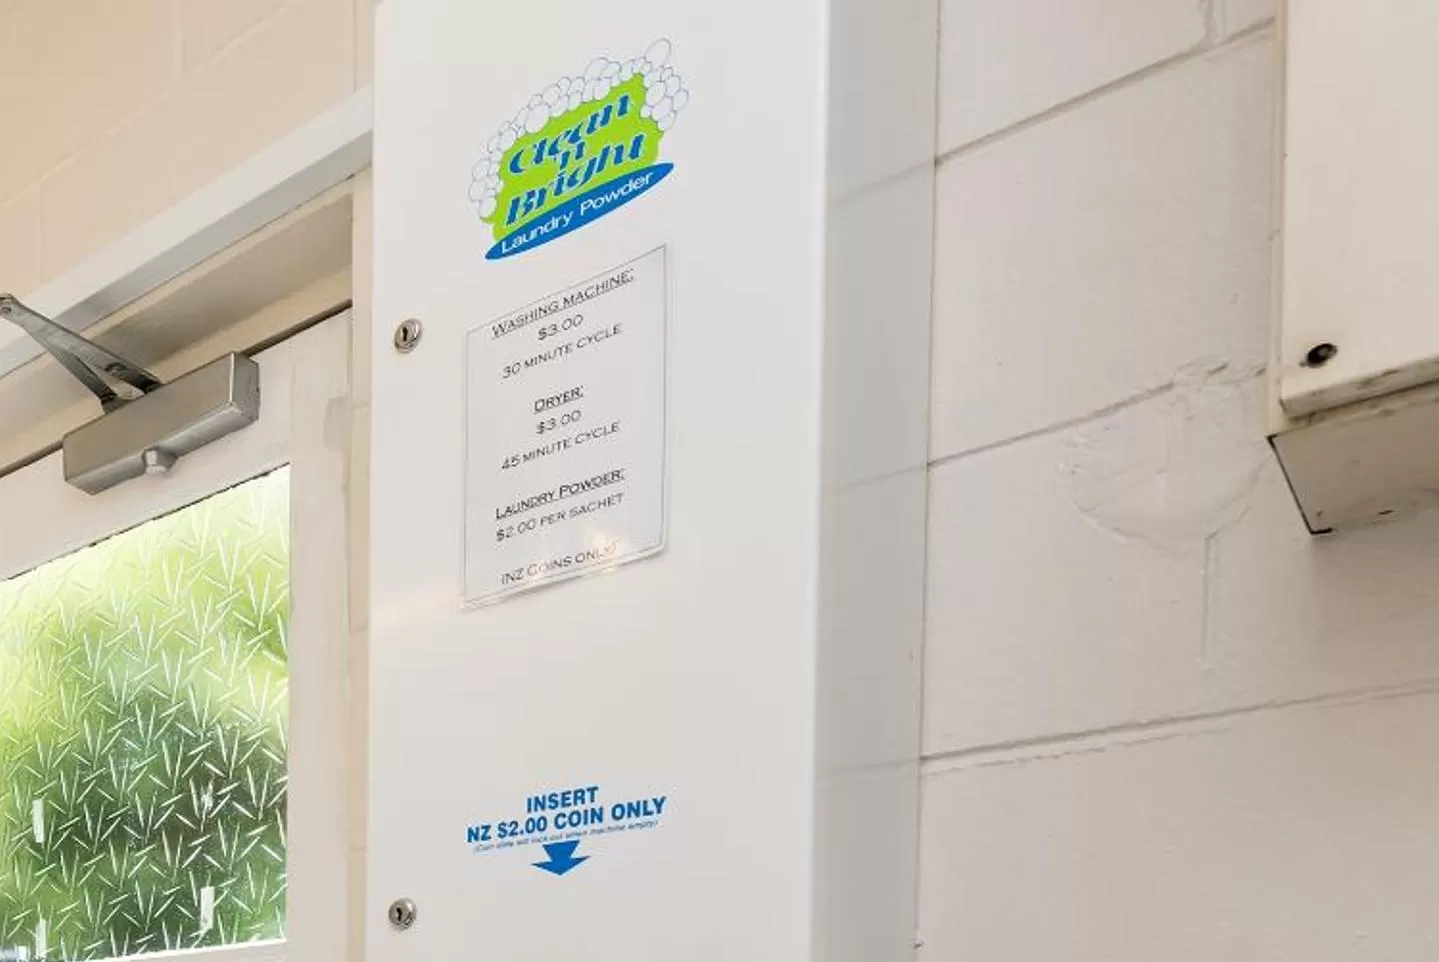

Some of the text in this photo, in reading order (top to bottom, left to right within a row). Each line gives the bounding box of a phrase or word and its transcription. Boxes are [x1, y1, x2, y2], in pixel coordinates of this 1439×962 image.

[509, 94, 630, 174] Clean
[506, 133, 645, 226] Bright
[501, 171, 654, 253] Laundry Powder
[491, 302, 559, 338] WASHING
[537, 313, 584, 341] $3.00
[502, 323, 623, 379] 30 MINUTE CYCLE
[501, 420, 620, 470] 45 MINUTE CYCLE
[536, 409, 582, 435] $3.00
[495, 490, 555, 520] LAUNDRY
[495, 492, 625, 542] $2.00 PER SACHET
[466, 795, 667, 843] NZ $2.00 COIN ONLY
[526, 786, 599, 813] INSERT
